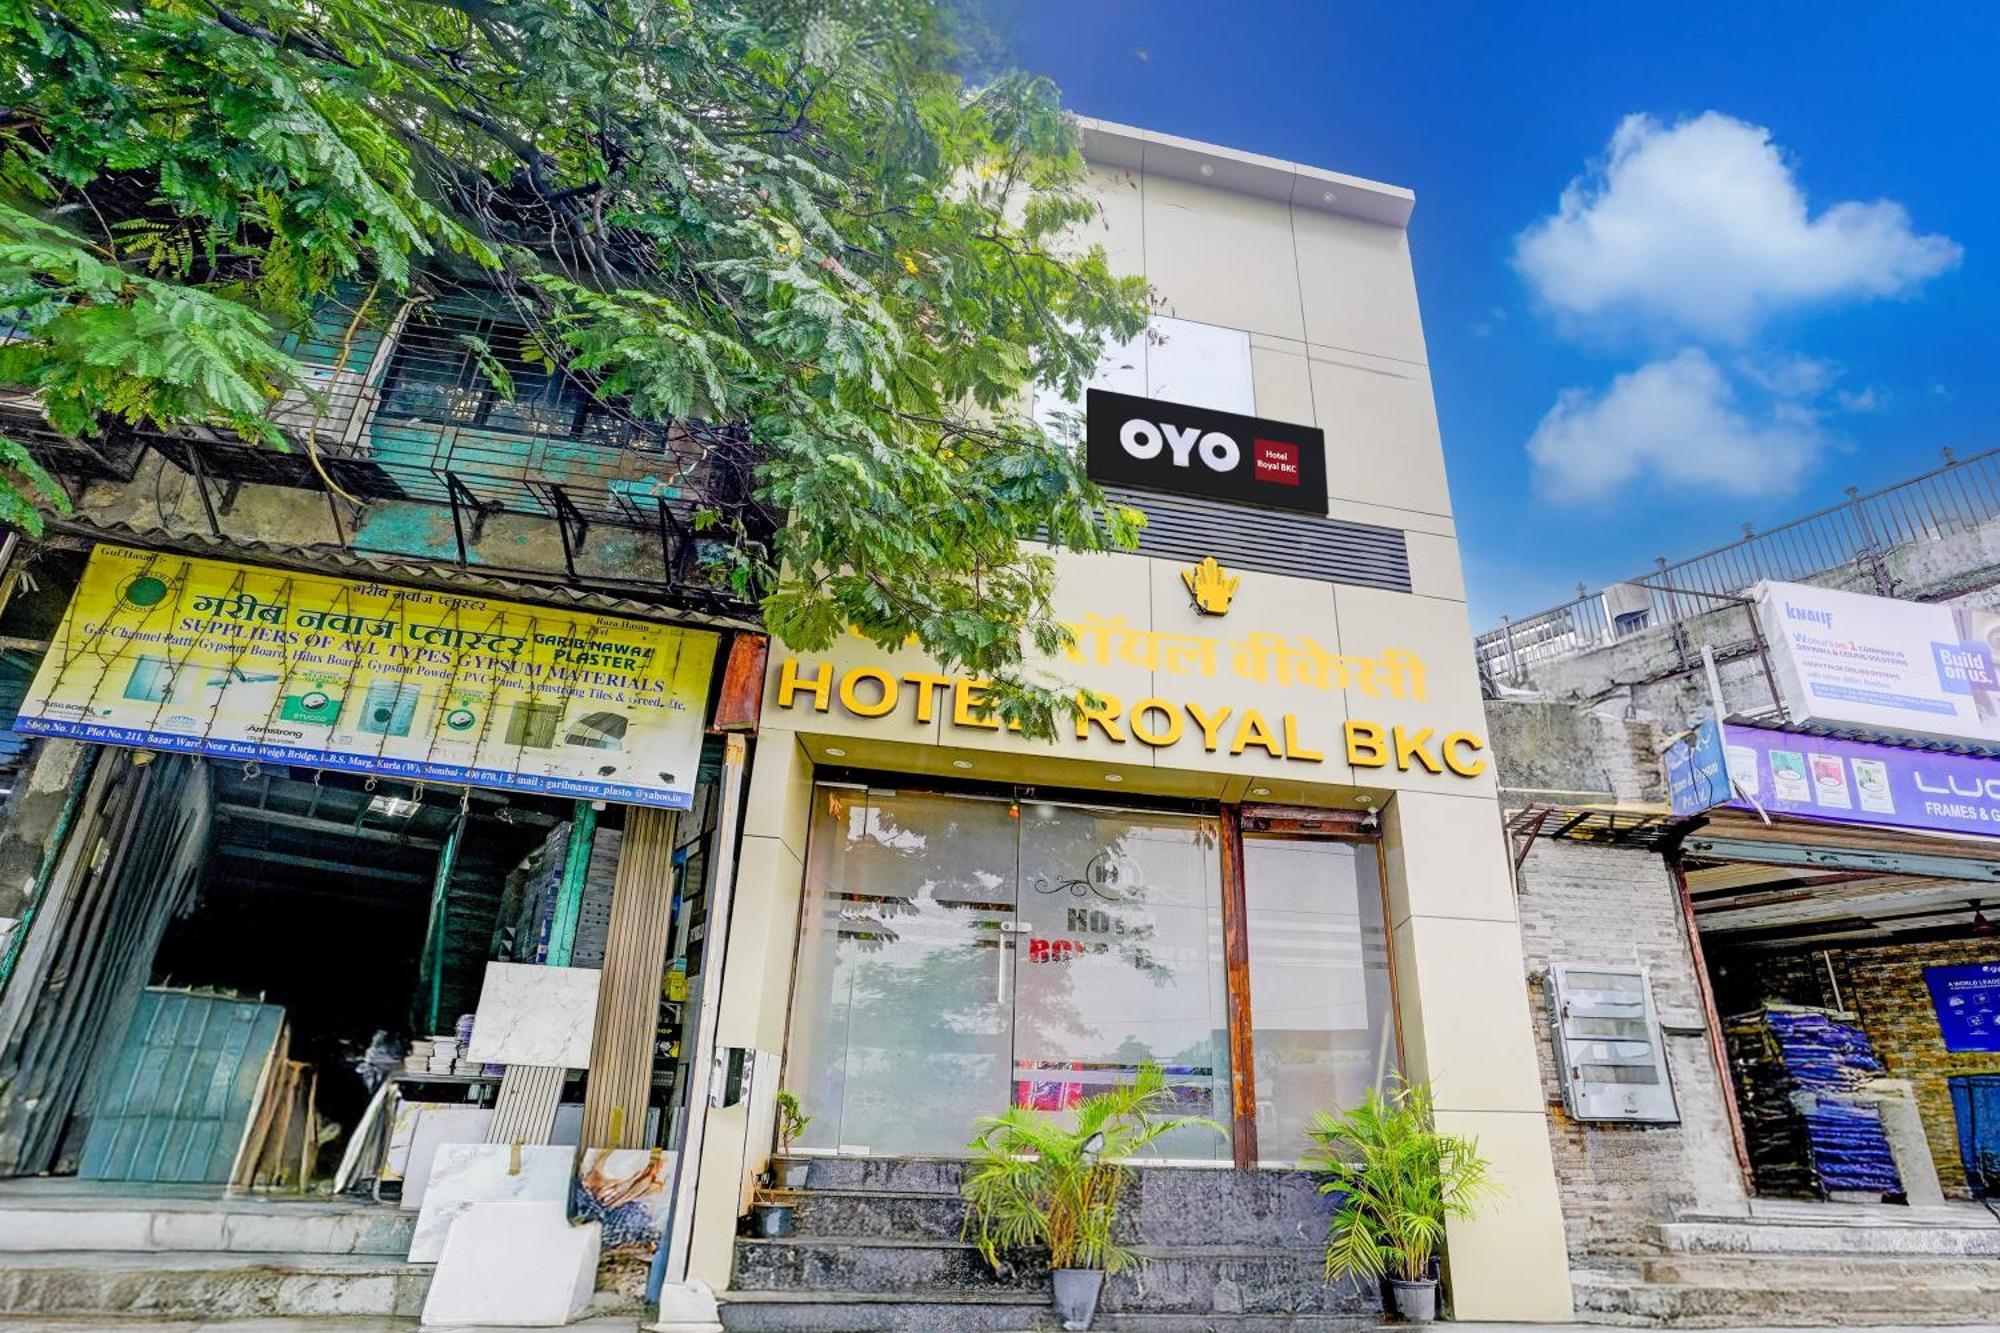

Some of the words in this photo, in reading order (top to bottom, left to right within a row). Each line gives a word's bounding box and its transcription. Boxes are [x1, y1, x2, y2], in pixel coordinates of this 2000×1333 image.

[1119, 418, 1241, 473] OYO
[1265, 450, 1288, 461] Hotel
[1257, 459, 1280, 472] Royal
[1280, 463, 1297, 473] BKC
[192, 593, 289, 626] गरीब
[296, 608, 400, 640] नवाज
[408, 623, 528, 657] प्लास्टर
[179, 616, 300, 645] SUPPLIERS
[304, 633, 336, 649] OF
[339, 639, 381, 657] ALL
[387, 642, 453, 666] TYPES
[458, 653, 543, 678] GYPSUM
[549, 665, 665, 693] MATERIALS
[533, 632, 586, 650] GARIB
[590, 640, 653, 659] NAWAZ
[1940, 648, 1985, 670] Build
[111, 624, 162, 642] Channel
[367, 658, 414, 675] Gypsum
[463, 671, 490, 685] PVC
[588, 686, 614, 701] Tiles
[615, 692, 625, 703] &
[554, 648, 637, 672] PLASTER
[1229, 630, 1430, 704] बीकेसी
[1944, 666, 1968, 681] on
[1967, 669, 1993, 684] us.
[246, 724, 304, 740] Armstrong
[1075, 686, 1324, 764] ROYAL
[1343, 718, 1487, 779] BKC
[86, 726, 106, 738] Plot
[107, 729, 123, 741] No.
[147, 734, 175, 746] Bazar
[206, 740, 231, 752] Near
[230, 742, 257, 755] Kurla
[258, 746, 286, 759] Weigh
[376, 759, 401, 771] Kurla
[506, 775, 538, 787] Email
[1924, 801, 1977, 820] FRAMES
[1979, 807, 1990, 821] &
